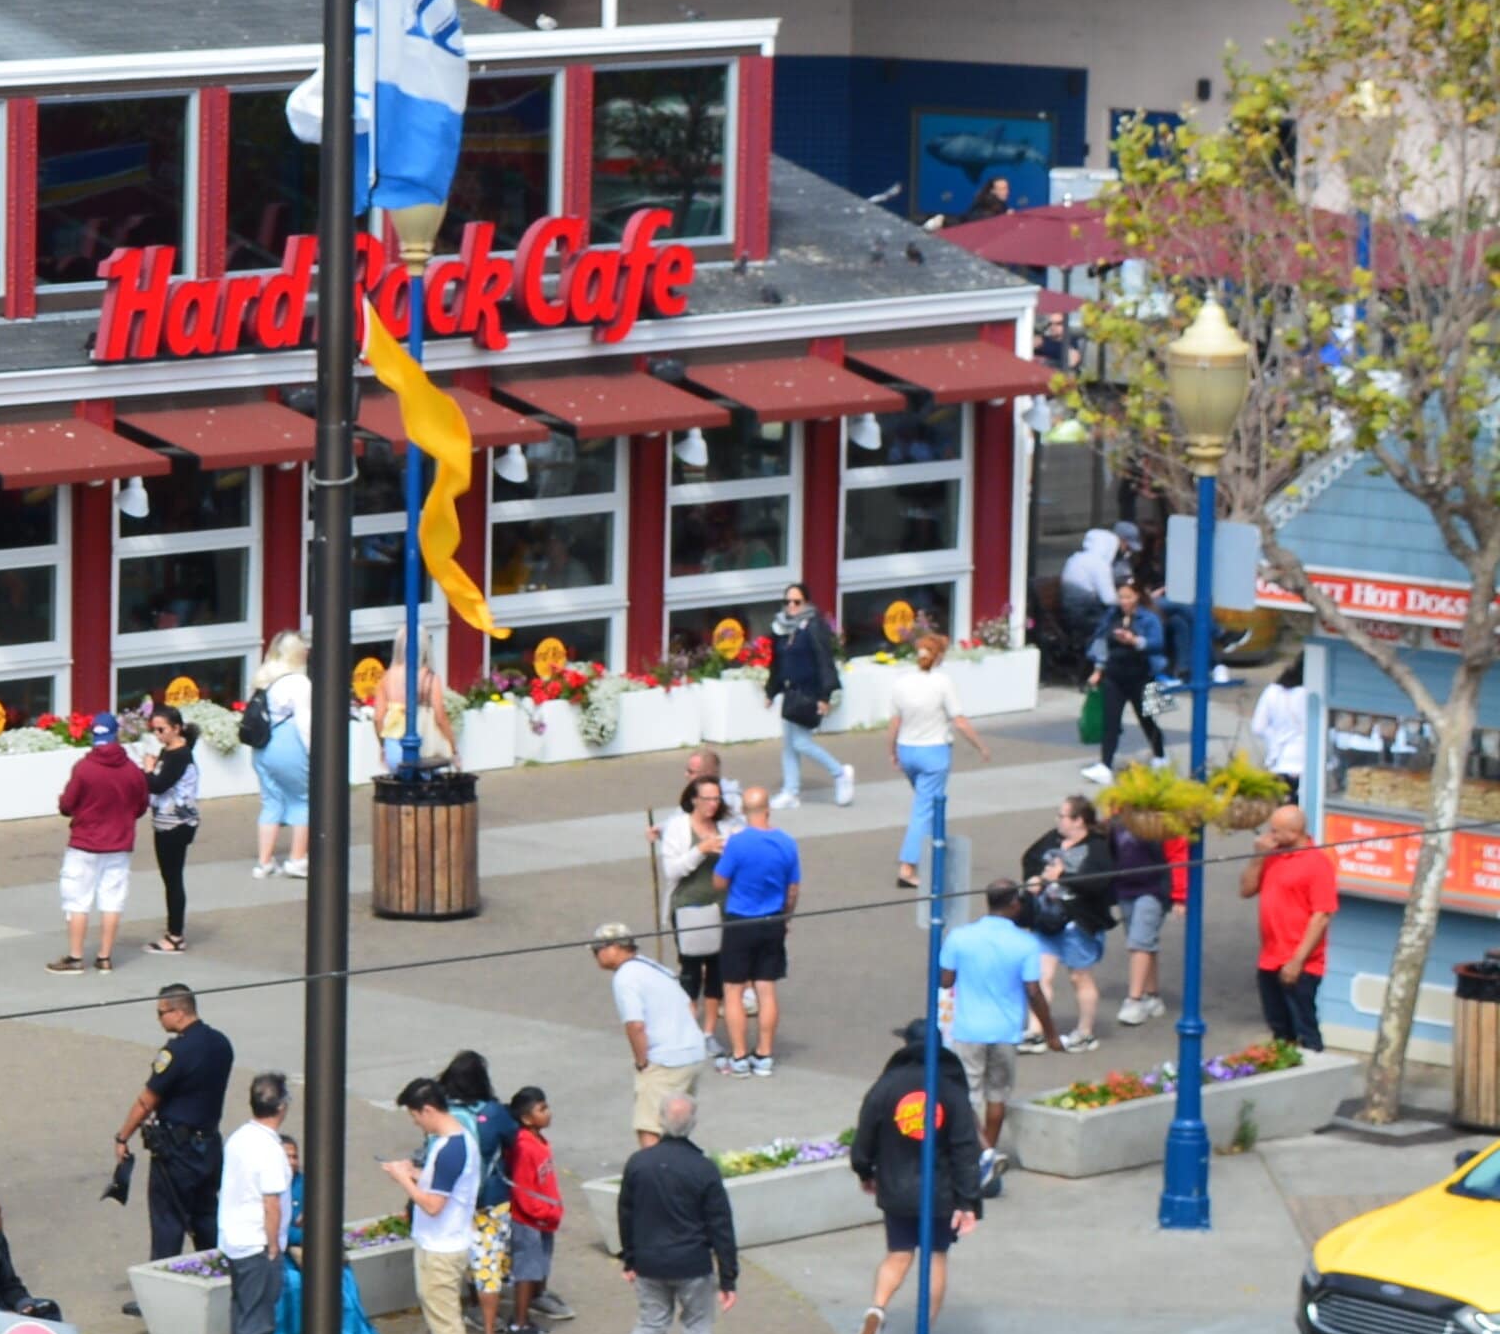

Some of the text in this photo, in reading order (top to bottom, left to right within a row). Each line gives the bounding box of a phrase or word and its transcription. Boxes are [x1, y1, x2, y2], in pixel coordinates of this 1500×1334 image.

[94, 233, 317, 361] Hard
[514, 207, 696, 345] Cafe
[1352, 582, 1403, 607] HOT
[1406, 588, 1470, 616] DOGS
